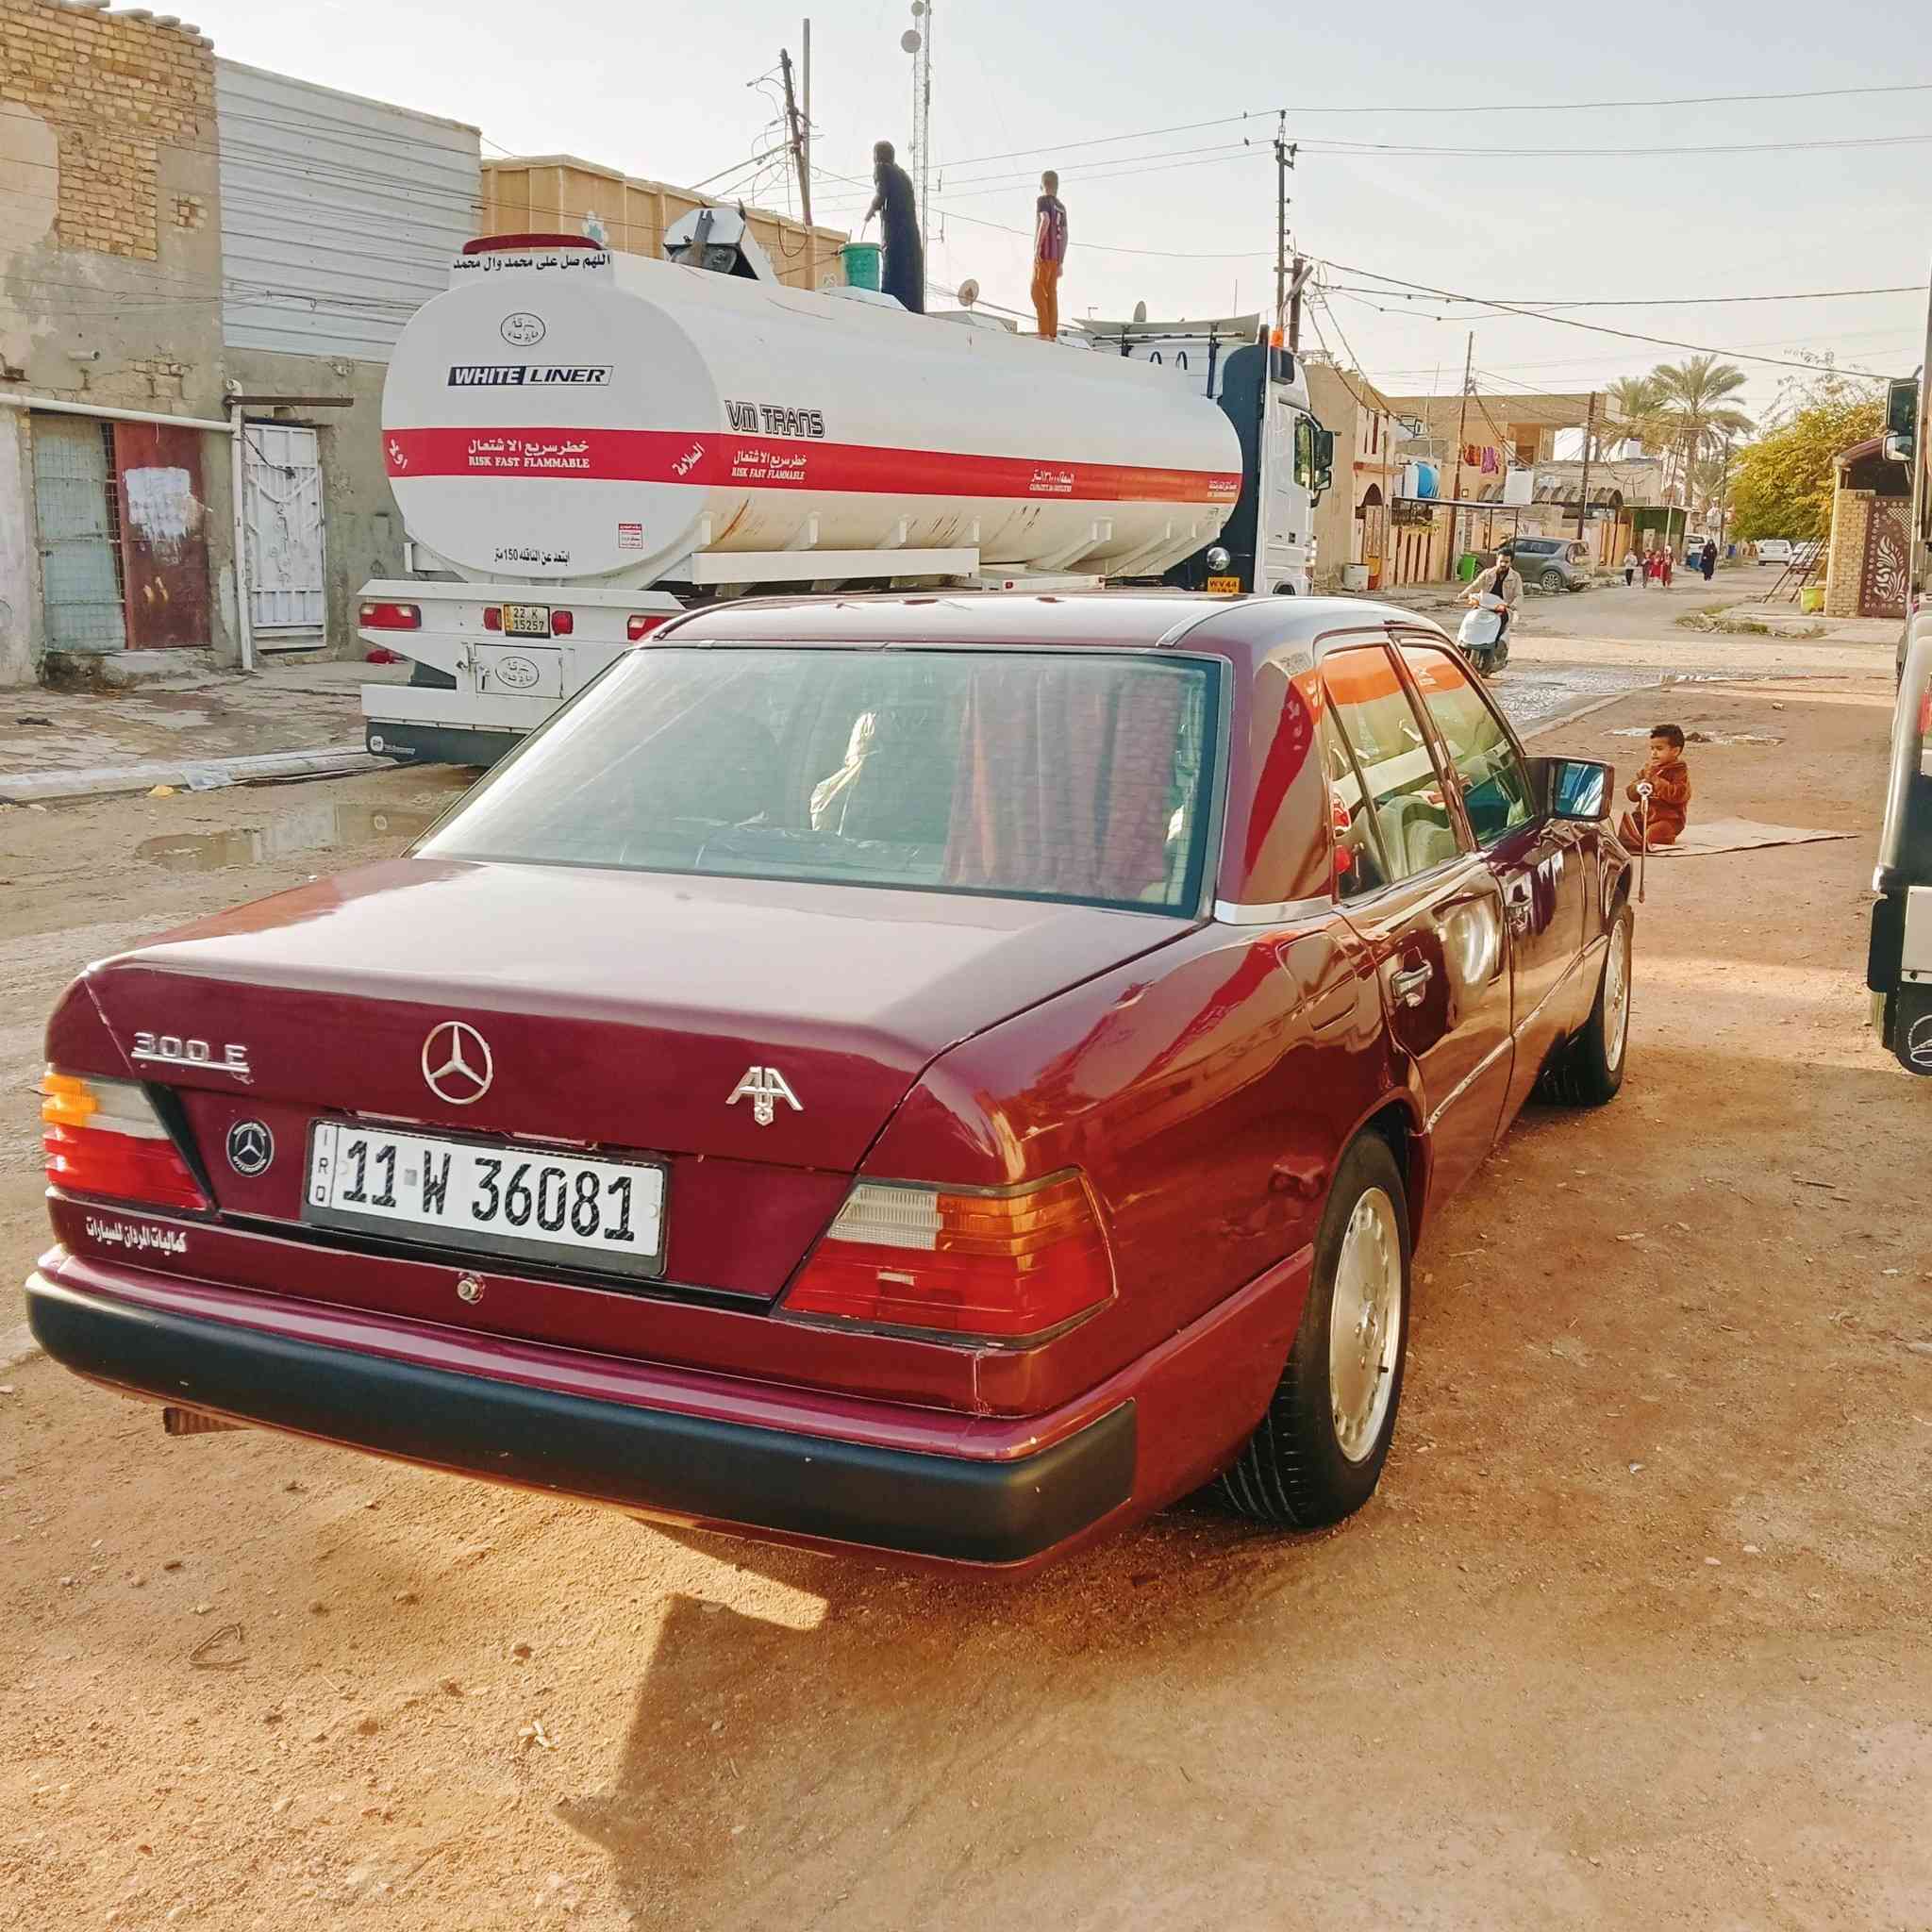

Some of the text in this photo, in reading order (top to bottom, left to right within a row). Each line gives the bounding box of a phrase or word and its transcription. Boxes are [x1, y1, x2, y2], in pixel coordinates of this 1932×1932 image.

[453, 258, 481, 269] محمد
[505, 257, 533, 268] محمد
[536, 255, 558, 271] على
[560, 255, 580, 270] صل
[582, 254, 611, 270] اللهم
[454, 367, 606, 385] WHITE LINER
[525, 441, 558, 457] سريع
[558, 439, 590, 455] خطر
[468, 457, 591, 469] RISK FAST FLAMMABLE
[770, 456, 790, 469] سريع
[789, 454, 808, 469] خطر
[732, 467, 748, 477] RISK
[749, 468, 766, 478] FAST
[504, 548, 519, 561] 150
[513, 608, 525, 619] 22
[513, 620, 544, 631] 15257
[134, 1031, 248, 1066] 300 E
[342, 1140, 635, 1242] 11 W 36081
[86, 1215, 124, 1245] للسيارات
[151, 1226, 188, 1256] كماليات
